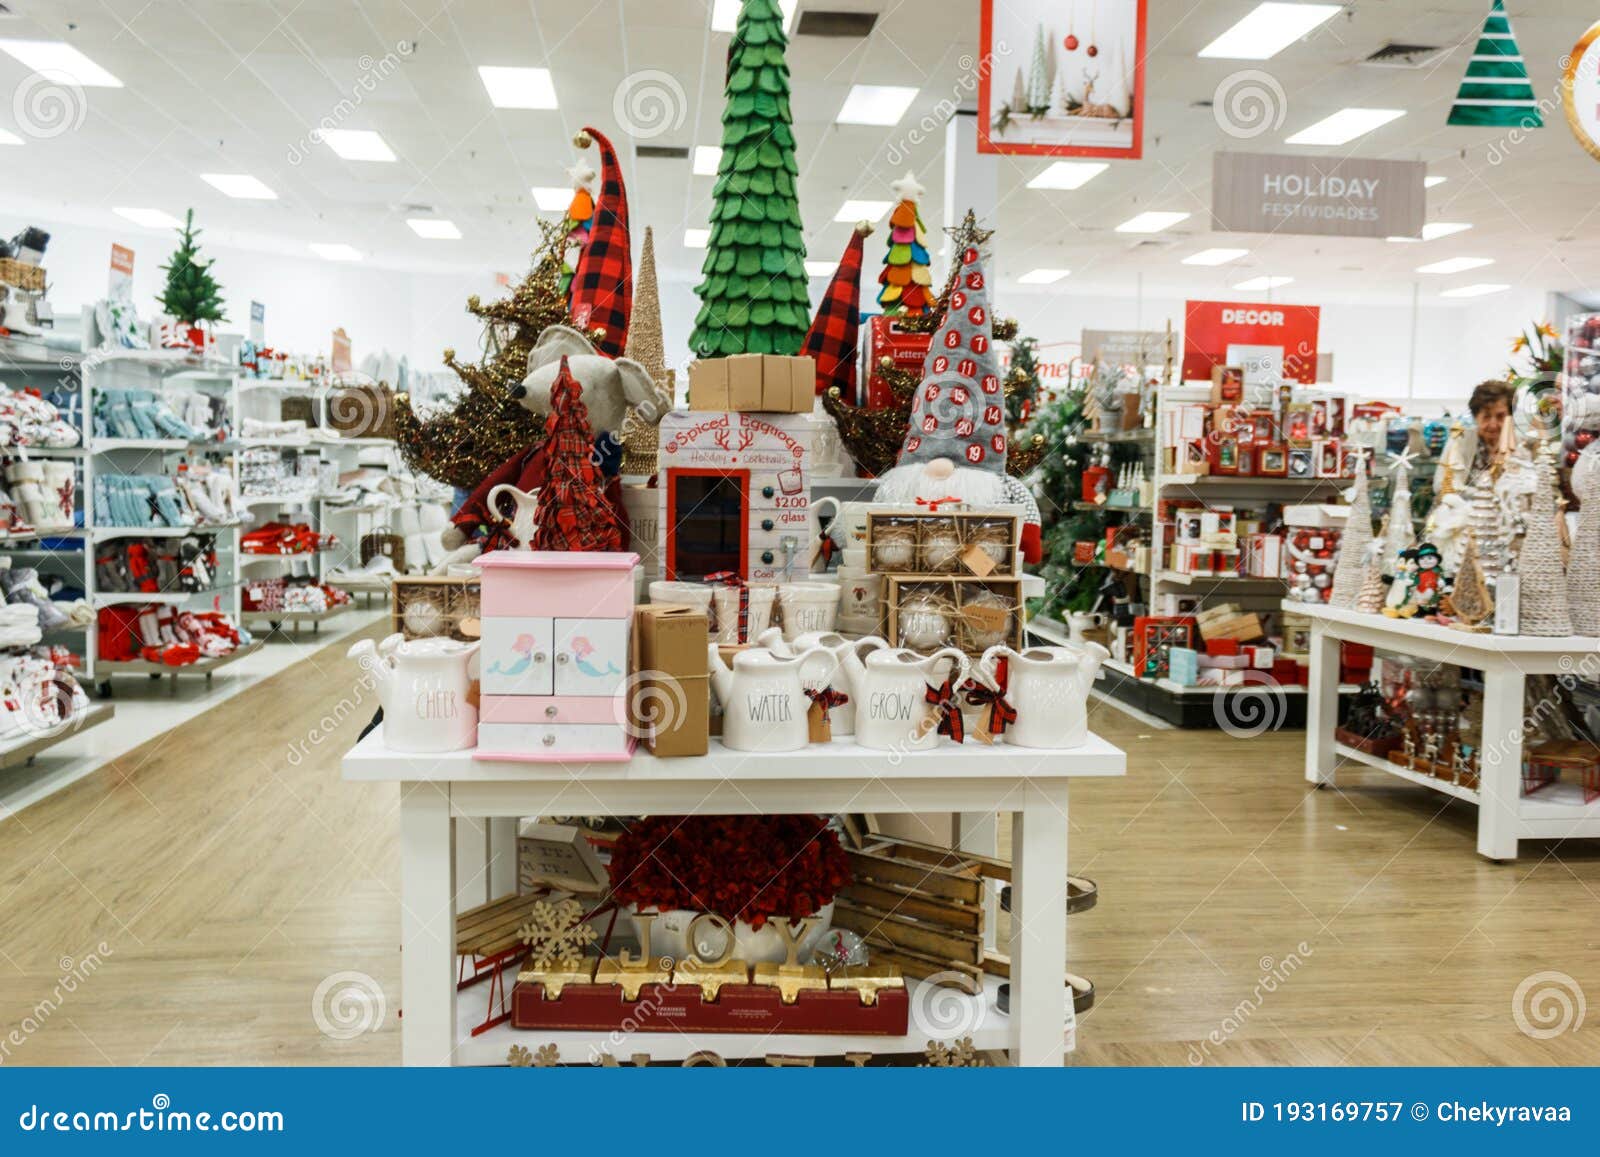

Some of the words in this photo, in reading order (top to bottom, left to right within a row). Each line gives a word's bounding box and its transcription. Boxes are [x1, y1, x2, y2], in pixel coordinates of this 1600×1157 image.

[1263, 174, 1380, 199] HOLIDAY
[1262, 202, 1379, 221] FESTIVIDADES
[971, 275, 981, 287] 2
[953, 294, 962, 307] 5
[972, 310, 982, 322] 4
[1221, 308, 1285, 326] DECOR
[948, 334, 956, 346] 8
[976, 338, 984, 351] 7
[935, 358, 946, 371] 12
[961, 361, 973, 375] 11
[985, 377, 997, 392] 10
[954, 389, 965, 402] 15
[988, 408, 1000, 422] 14
[675, 414, 729, 446] Spiced
[739, 414, 796, 449] Eggnog
[957, 421, 972, 434] 20
[690, 451, 726, 465] Holiday
[969, 446, 982, 460] 19
[416, 688, 458, 720] CHEER
[747, 694, 793, 723] WATER
[870, 692, 916, 721] GROW
